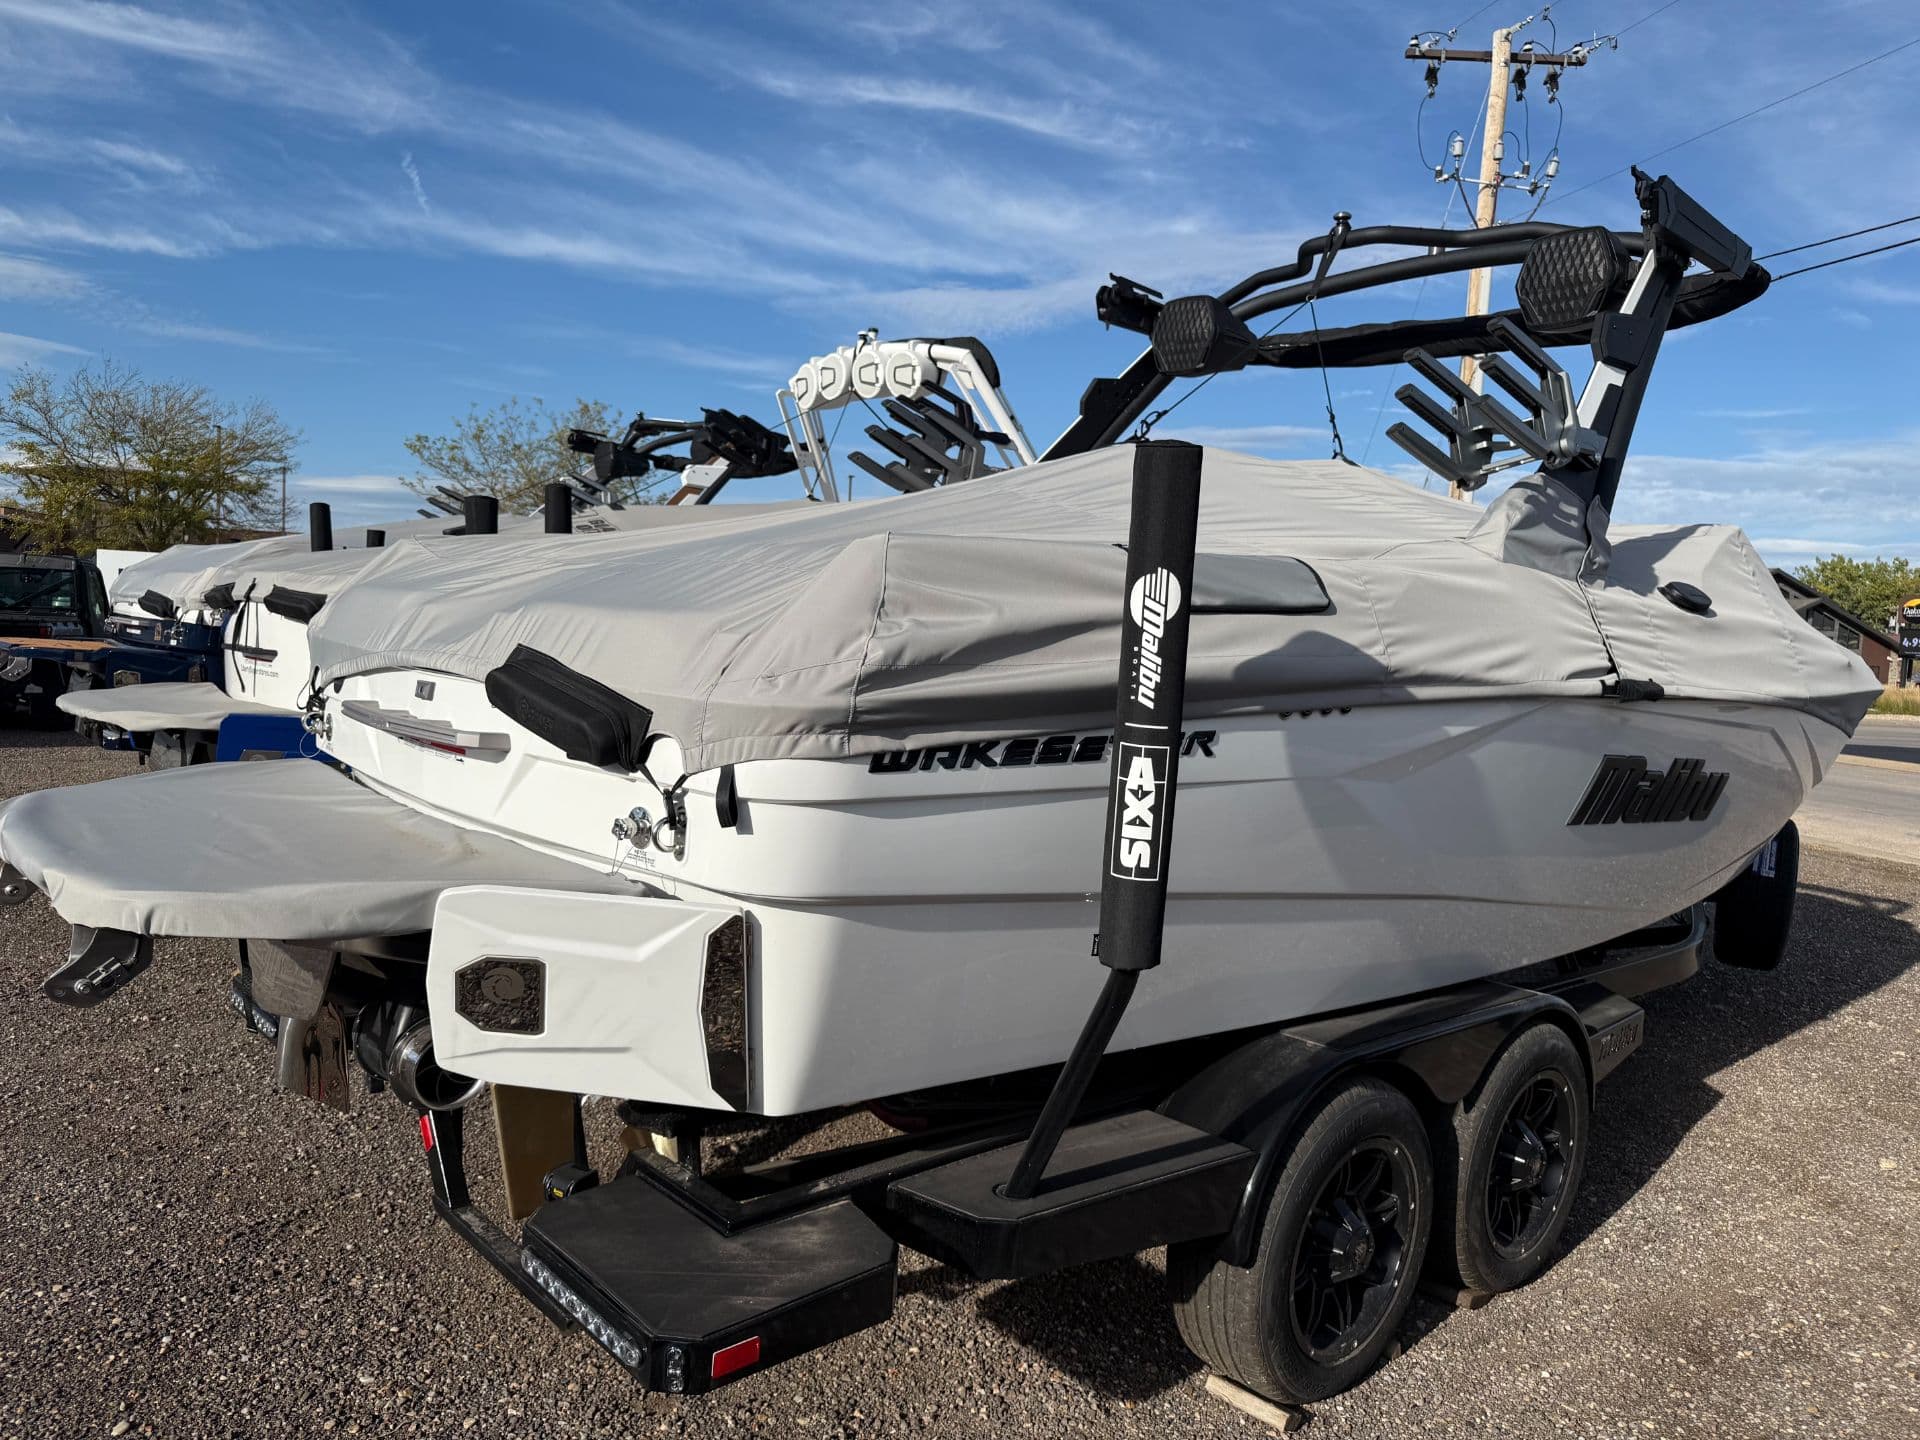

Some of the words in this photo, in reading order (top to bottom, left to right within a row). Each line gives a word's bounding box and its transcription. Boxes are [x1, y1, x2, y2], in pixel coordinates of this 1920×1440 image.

[1138, 593, 1167, 710] Malibu
[1902, 636, 1920, 648] 4.9
[868, 729, 1217, 774] WAKESER
[1118, 756, 1156, 869] AXIS
[1566, 754, 1730, 826] Malibu
